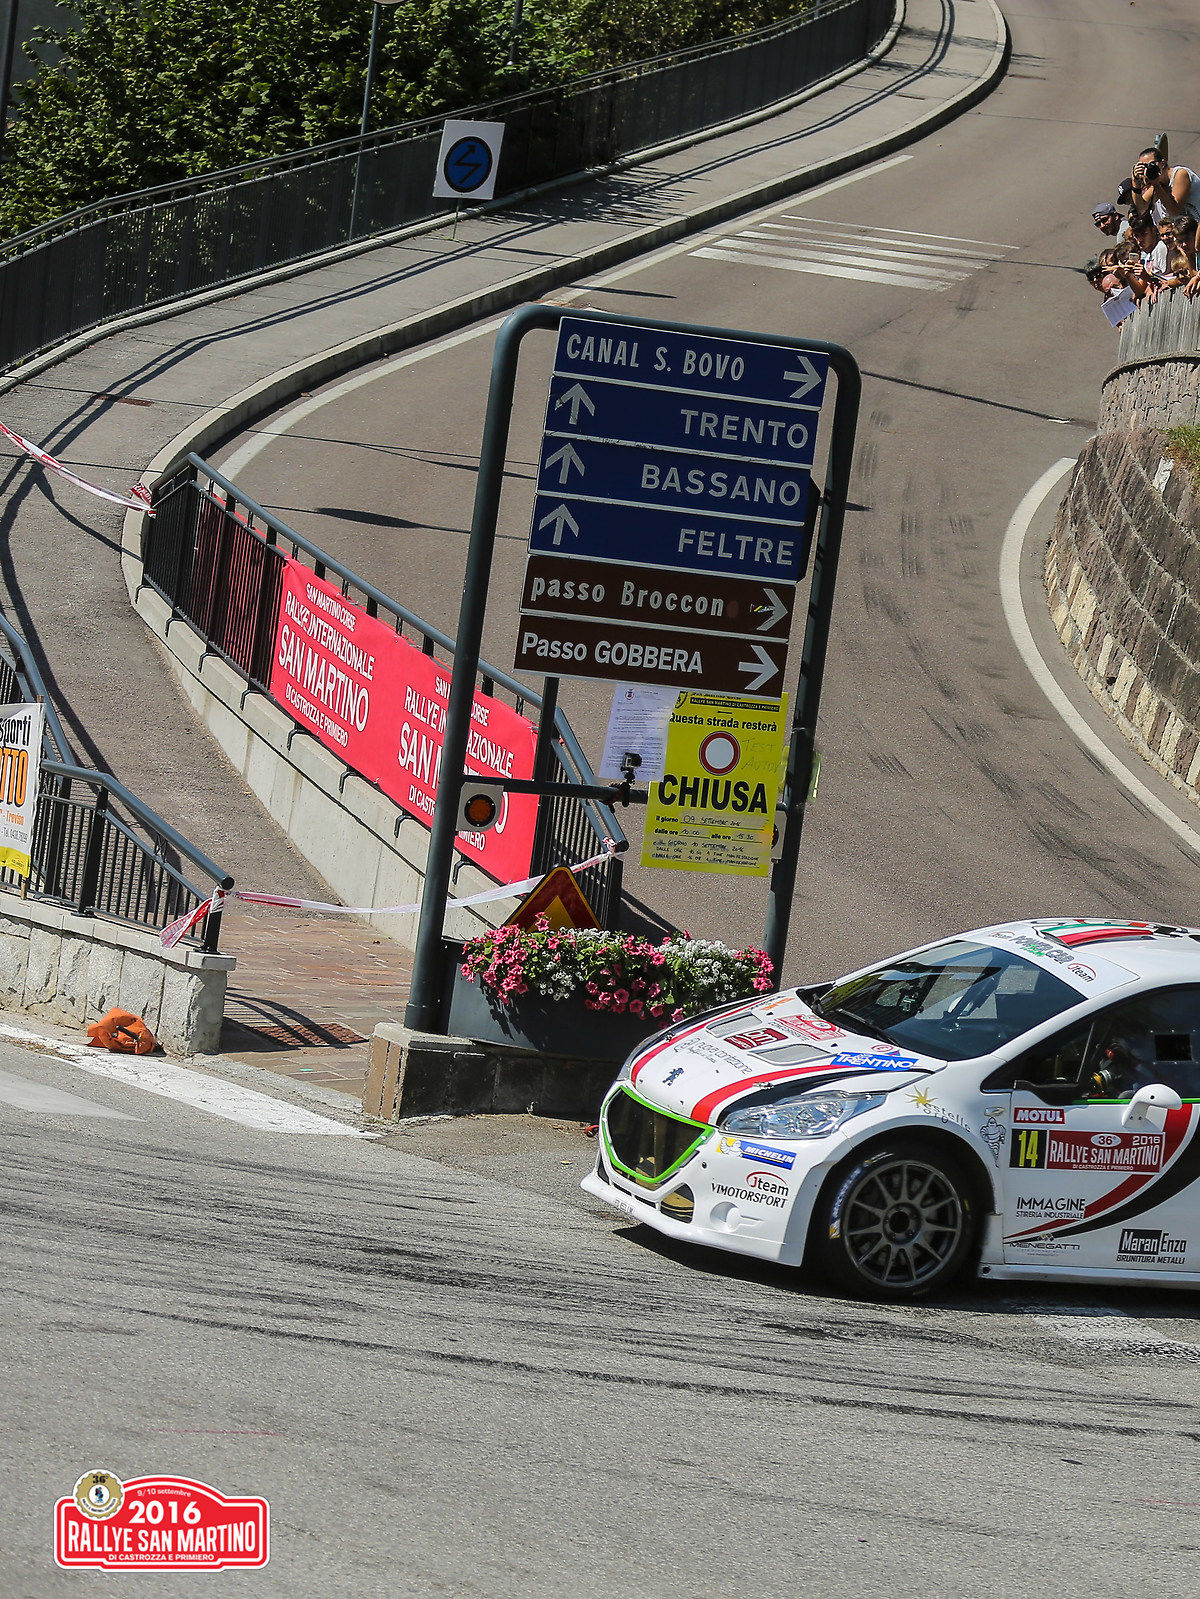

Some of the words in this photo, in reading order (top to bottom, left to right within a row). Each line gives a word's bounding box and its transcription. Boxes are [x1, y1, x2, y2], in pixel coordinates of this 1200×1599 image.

[566, 333, 639, 368] CANAL
[654, 346, 672, 372] S.
[683, 349, 745, 381] BOVO
[680, 408, 808, 448] TRENTO
[641, 464, 801, 506] BASSANO
[678, 528, 794, 565] FELTRE
[305, 583, 318, 606] SAN
[339, 607, 357, 632] CORSE
[531, 574, 605, 602] passo
[621, 581, 724, 617] Broccon
[284, 590, 309, 632] RALLYE
[308, 613, 375, 682] INTERNAZIONALE
[522, 632, 586, 660] Passo
[594, 640, 703, 674] GOBBERA
[278, 624, 306, 684] SAN
[302, 646, 369, 732] MARTINO
[404, 685, 437, 730] RALLYE
[706, 716, 739, 729] strada
[742, 720, 777, 732] resterà
[398, 721, 434, 784] SAN
[408, 784, 417, 804] DI
[657, 774, 768, 814] CHIUSA
[654, 827, 668, 835] dalle
[836, 1053, 914, 1069] TRENTINO
[1016, 1109, 1063, 1122] MOTUL
[1018, 1130, 1039, 1168] 14
[1049, 1140, 1089, 1164] RALLYE
[1090, 1147, 1112, 1164] SAN
[1113, 1145, 1160, 1166] MARTINO
[1098, 1135, 1117, 1145] 36°
[1132, 1135, 1161, 1146] 2016
[744, 1146, 795, 1163] MICHELIN
[711, 1183, 789, 1208] VIMOTORSPORT
[749, 1176, 789, 1196] Jteam
[1016, 1196, 1086, 1211] IMMAGINE
[1043, 1211, 1084, 1220] INDUSTRIALE
[1008, 1242, 1080, 1250] MENEGATTI
[1121, 1231, 1157, 1252] Maran
[1161, 1232, 1187, 1253] Enzo
[1116, 1255, 1155, 1263] BRUNITURA
[1156, 1256, 1185, 1264] METALLI
